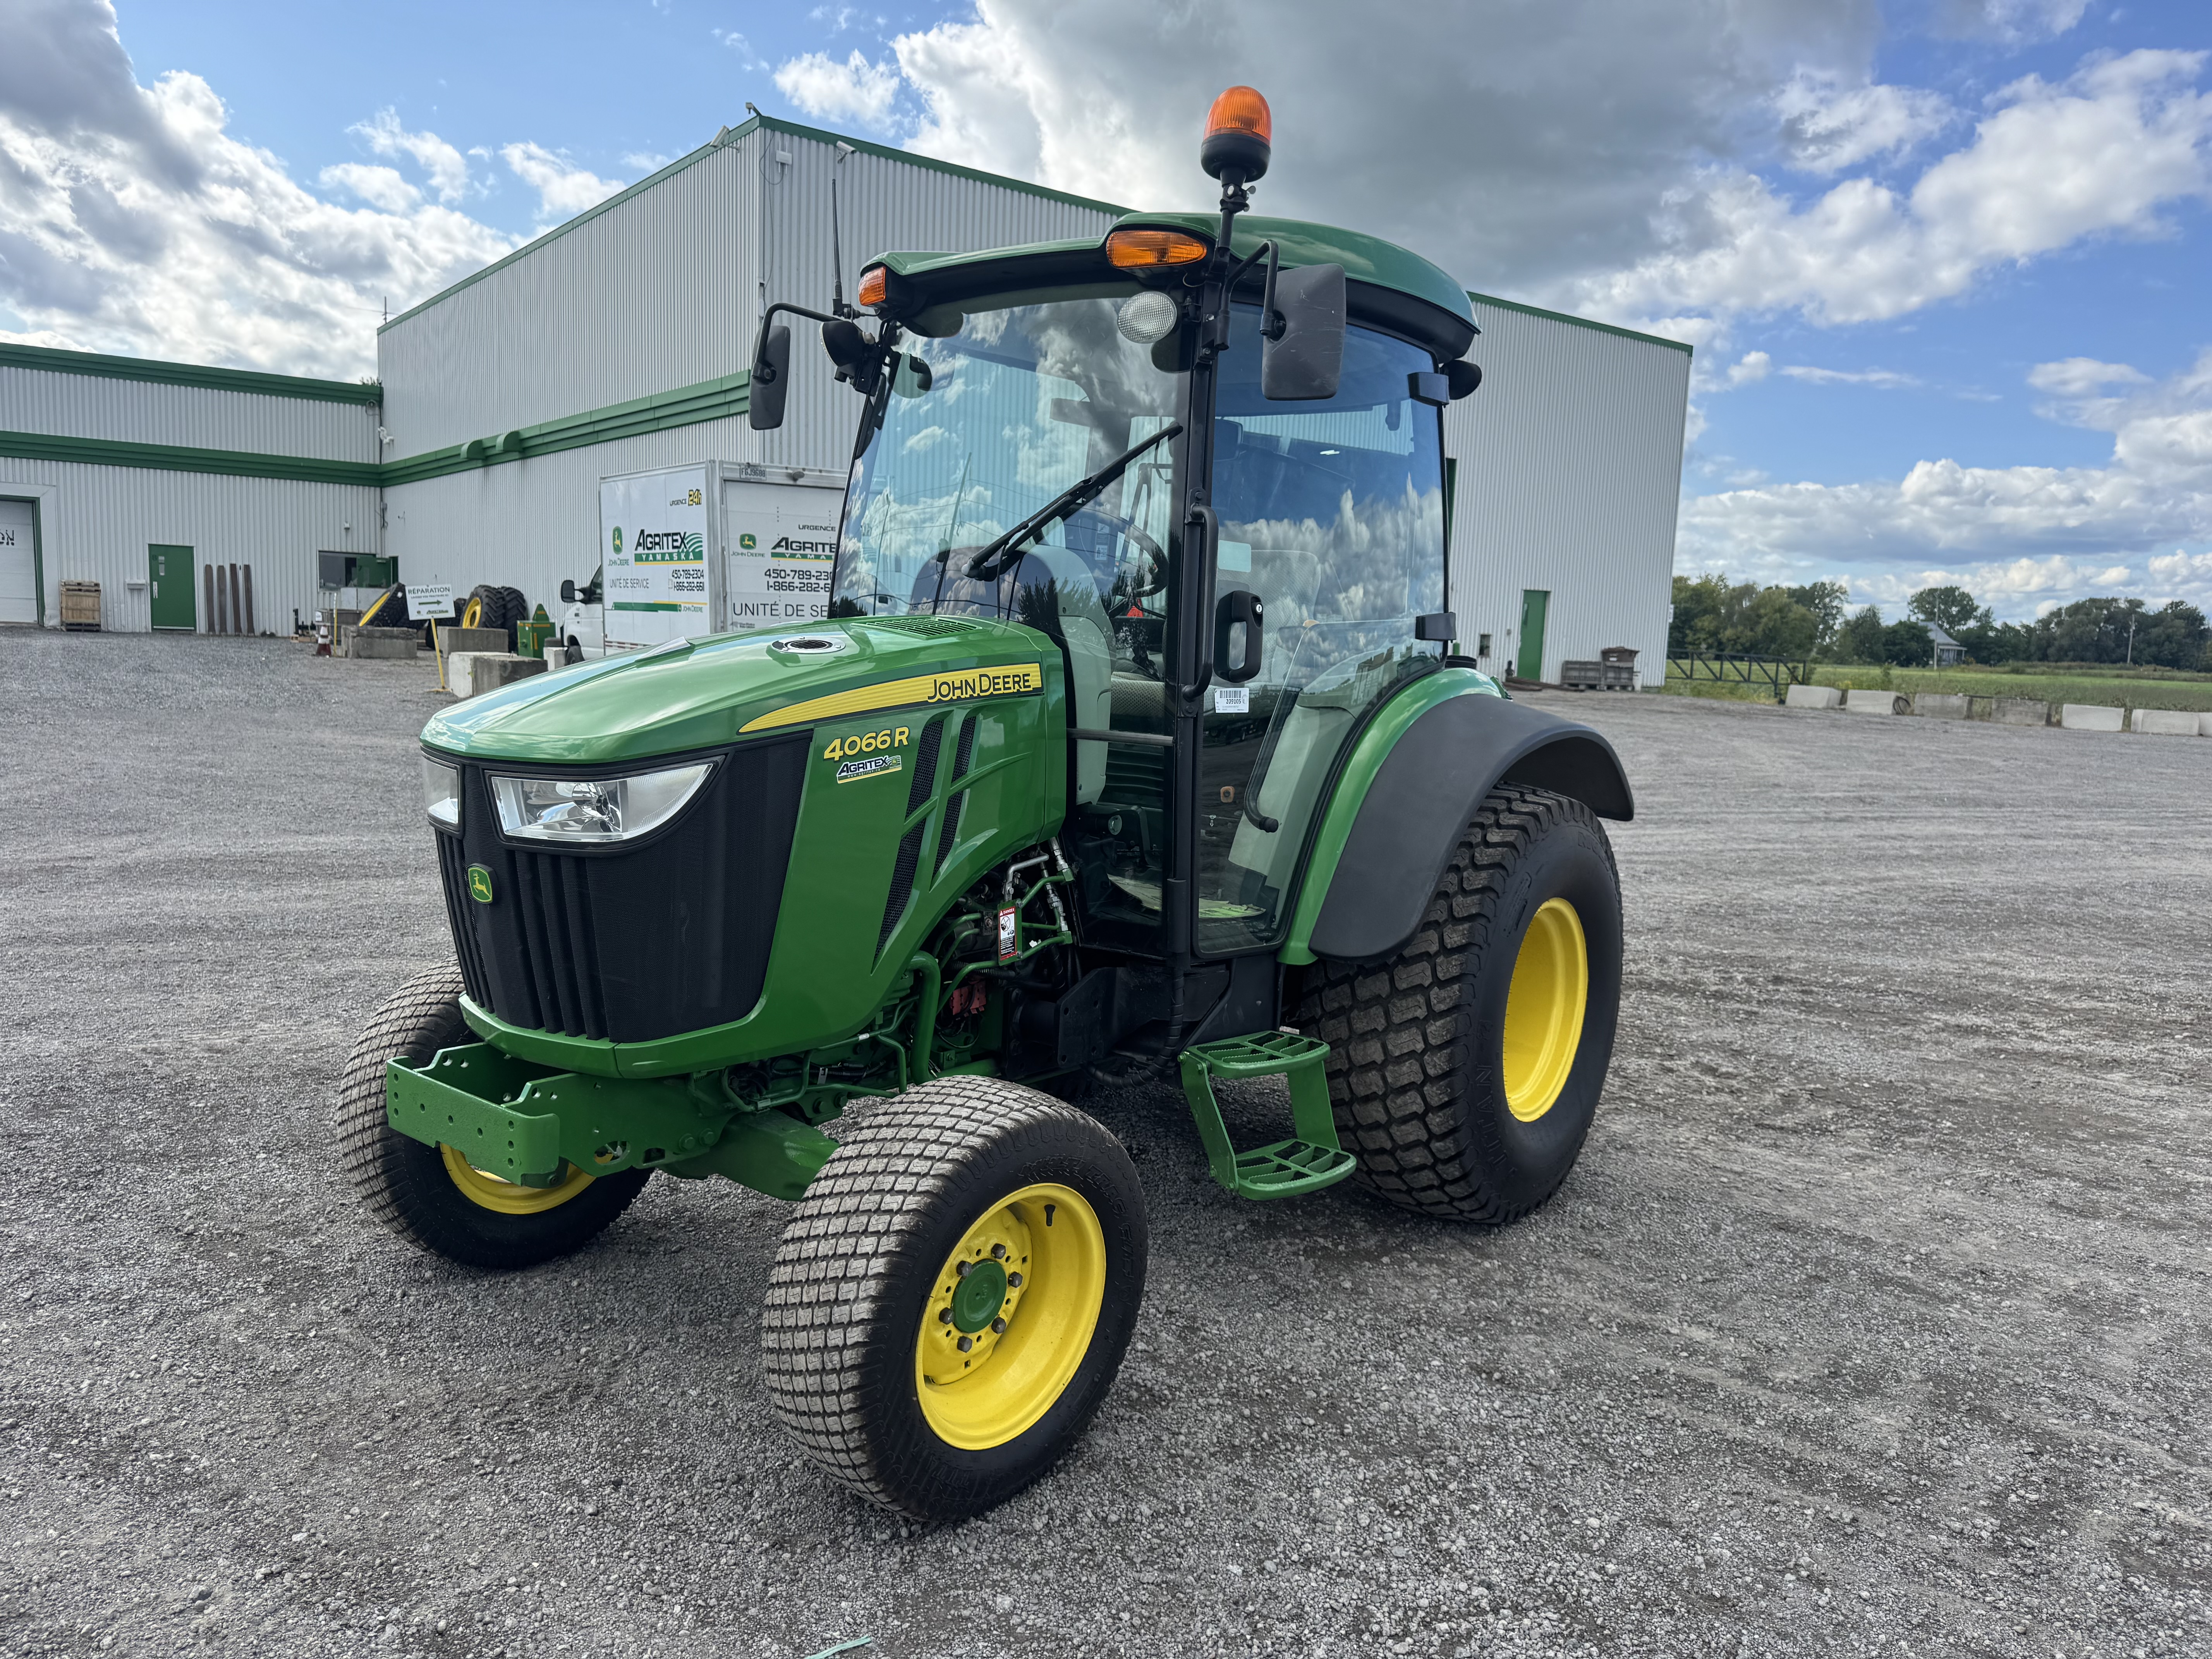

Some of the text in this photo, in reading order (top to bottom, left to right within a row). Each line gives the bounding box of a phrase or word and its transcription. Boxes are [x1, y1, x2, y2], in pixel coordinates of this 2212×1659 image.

[688, 489, 702, 506] 24h
[635, 529, 689, 551] AGRITEX
[618, 558, 629, 566] DEERE
[642, 552, 694, 562] YAMASKA
[672, 569, 704, 579] 450-789-2304
[610, 577, 649, 589] UNITÉ DE SERVICE
[408, 587, 450, 595] RÉPARATION
[733, 601, 779, 617] UNITÉ
[785, 604, 805, 617] DE
[927, 673, 1032, 700] JOHN DEERE
[838, 757, 888, 776] AGRITEX
